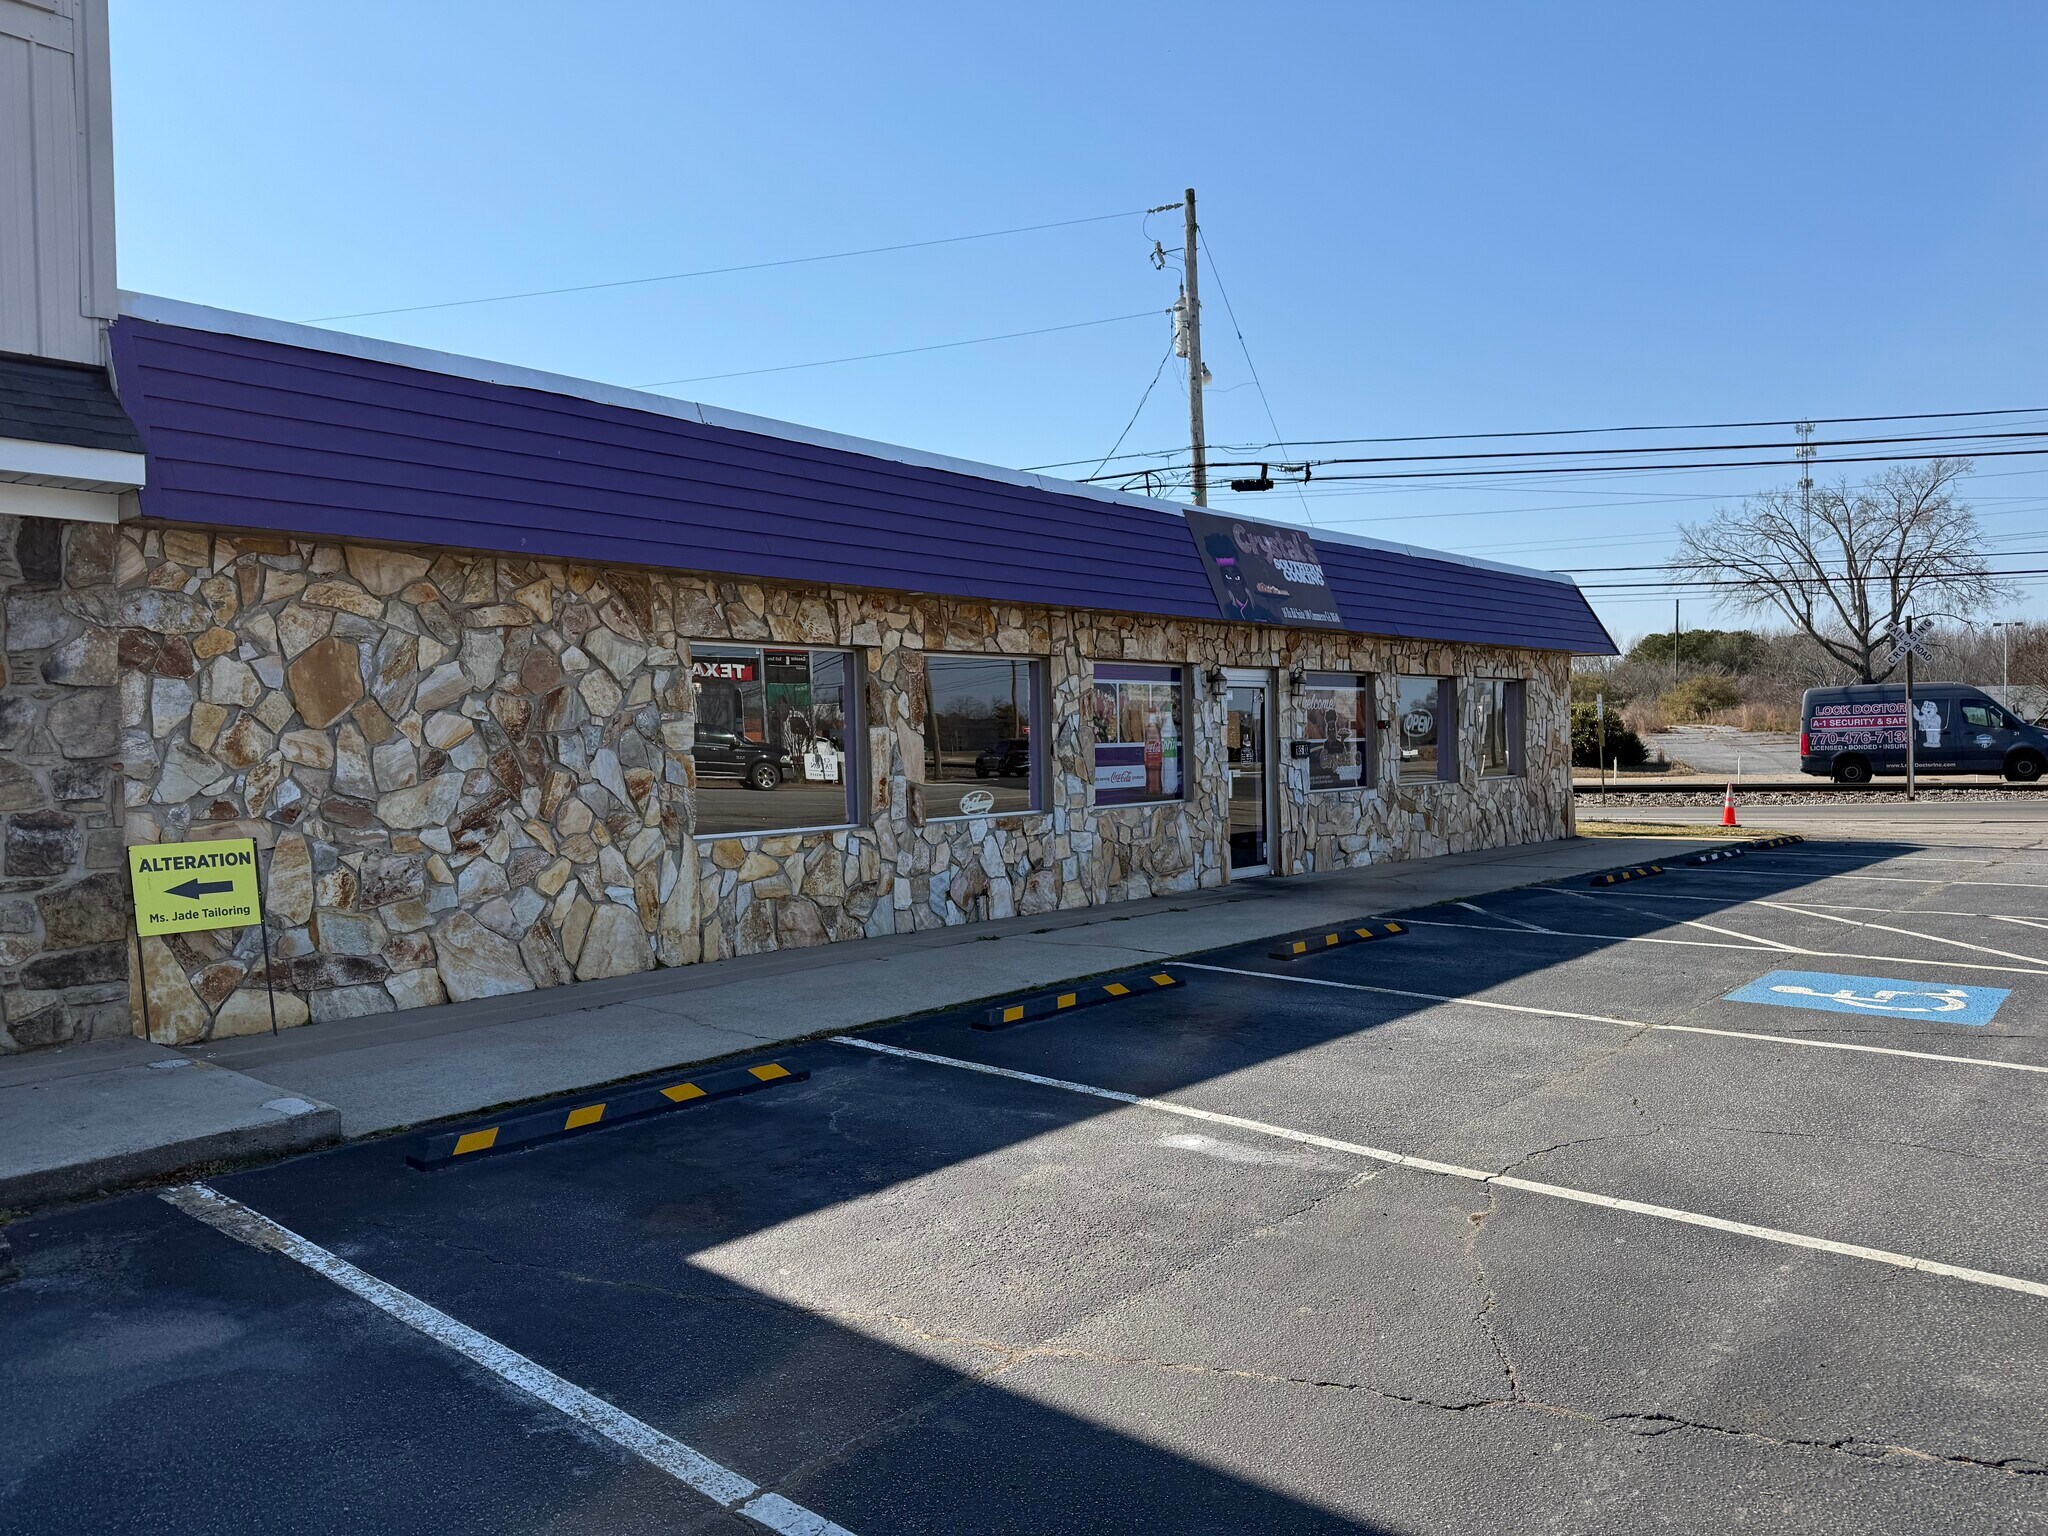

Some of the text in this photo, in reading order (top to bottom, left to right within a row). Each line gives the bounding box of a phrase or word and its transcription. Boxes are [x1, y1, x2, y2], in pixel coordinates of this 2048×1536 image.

[1233, 523, 1318, 565] Crystal's
[1273, 558, 1324, 576] SOUTHERN
[1283, 569, 1324, 587] COOKING
[1815, 704, 1851, 715] LOCK
[1405, 713, 1431, 733] OPEN
[1829, 718, 1875, 727] SECURITY
[1885, 717, 1907, 725] SAF
[139, 852, 251, 873] ALTERATION
[149, 906, 251, 923] Ms. Jade Tailoring
